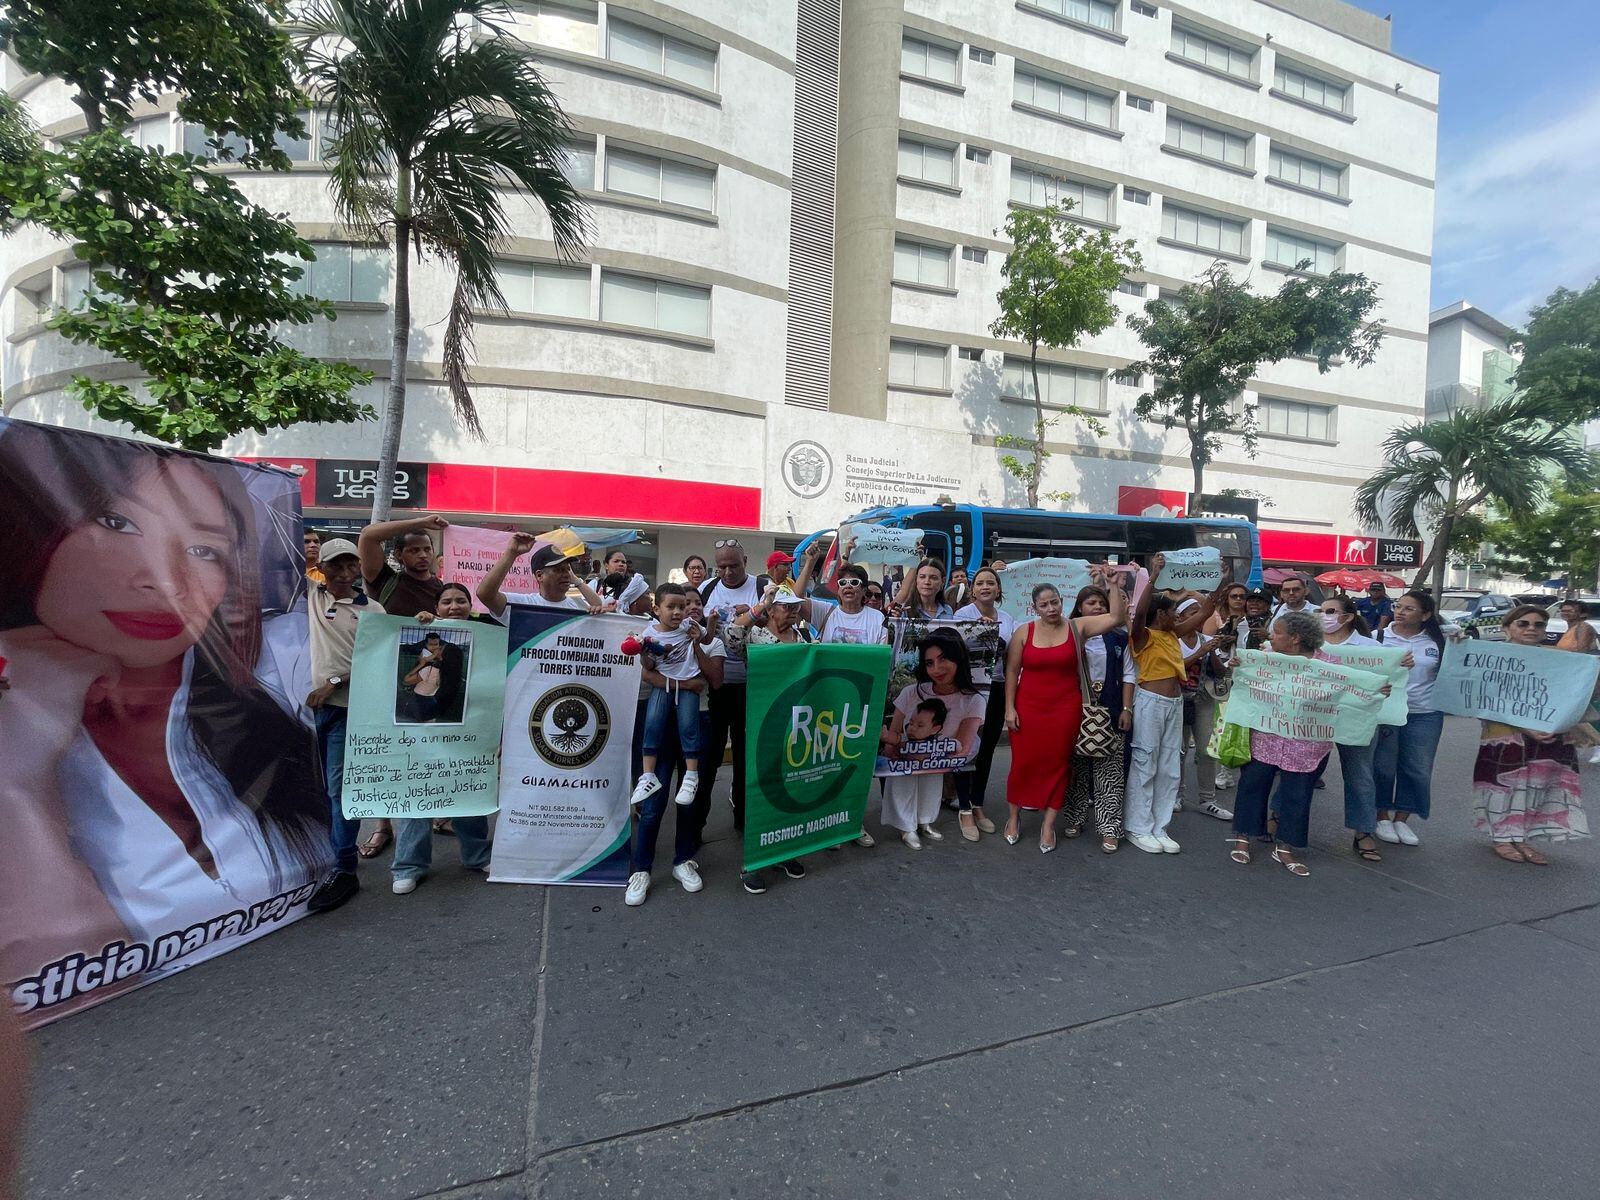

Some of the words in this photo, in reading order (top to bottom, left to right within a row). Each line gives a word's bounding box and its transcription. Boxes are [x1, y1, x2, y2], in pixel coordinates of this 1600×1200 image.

[846, 454, 868, 463] Rama
[869, 456, 899, 467] Judicial
[333, 469, 410, 485] TURO
[846, 465, 874, 476] Consejo
[875, 468, 905, 479] Superior
[906, 472, 916, 480] De
[916, 473, 925, 481] La
[926, 474, 961, 485] Judicatura
[333, 484, 410, 499] JEAS
[894, 485, 926, 494] Colombia
[844, 492, 875, 505] SANTA
[878, 494, 909, 506] MARTA
[1384, 544, 1414, 553] TURKO
[1384, 553, 1414, 562] JEANS
[458, 561, 482, 571] MARIO
[557, 635, 605, 650] FUNDACION
[521, 648, 600, 663] AFROCOLOMBIANA
[601, 653, 635, 666] SUSANA
[1263, 655, 1282, 667] Juez
[1303, 665, 1313, 673] es
[1347, 656, 1355, 664] LA
[1359, 656, 1384, 667] MUJER
[1464, 653, 1526, 672] EXIGIMOS
[539, 662, 572, 675] TORRES
[575, 665, 612, 678] VERGARA
[1292, 673, 1324, 687] obtener
[1498, 681, 1548, 707] PROCESO
[1302, 703, 1340, 716] entender
[1512, 702, 1556, 722] GOMEZ
[1261, 715, 1335, 739] FEMINICIDIO
[1293, 716, 1304, 725] es
[1308, 716, 1317, 725] un
[349, 733, 392, 746] Miserable
[398, 731, 416, 747] dejo
[429, 735, 439, 743] un
[464, 734, 476, 742] sin
[900, 739, 956, 754] Justicia
[407, 753, 419, 771] Le
[449, 757, 457, 768] la
[890, 760, 919, 775] Yaya
[922, 756, 966, 769] Gómez
[344, 777, 351, 785] a
[354, 775, 365, 784] un
[390, 770, 402, 781] de
[438, 770, 451, 778] con
[454, 768, 463, 776] su
[466, 766, 487, 775] madre
[521, 775, 610, 789] GUAMACHITO
[451, 778, 488, 793] Justicia
[349, 807, 375, 818] Para
[760, 825, 804, 846] ROSMUC
[806, 810, 850, 834] NACIONAL
[12, 946, 144, 1013] sticia
[153, 913, 243, 968] para
[244, 883, 316, 934] yaya
